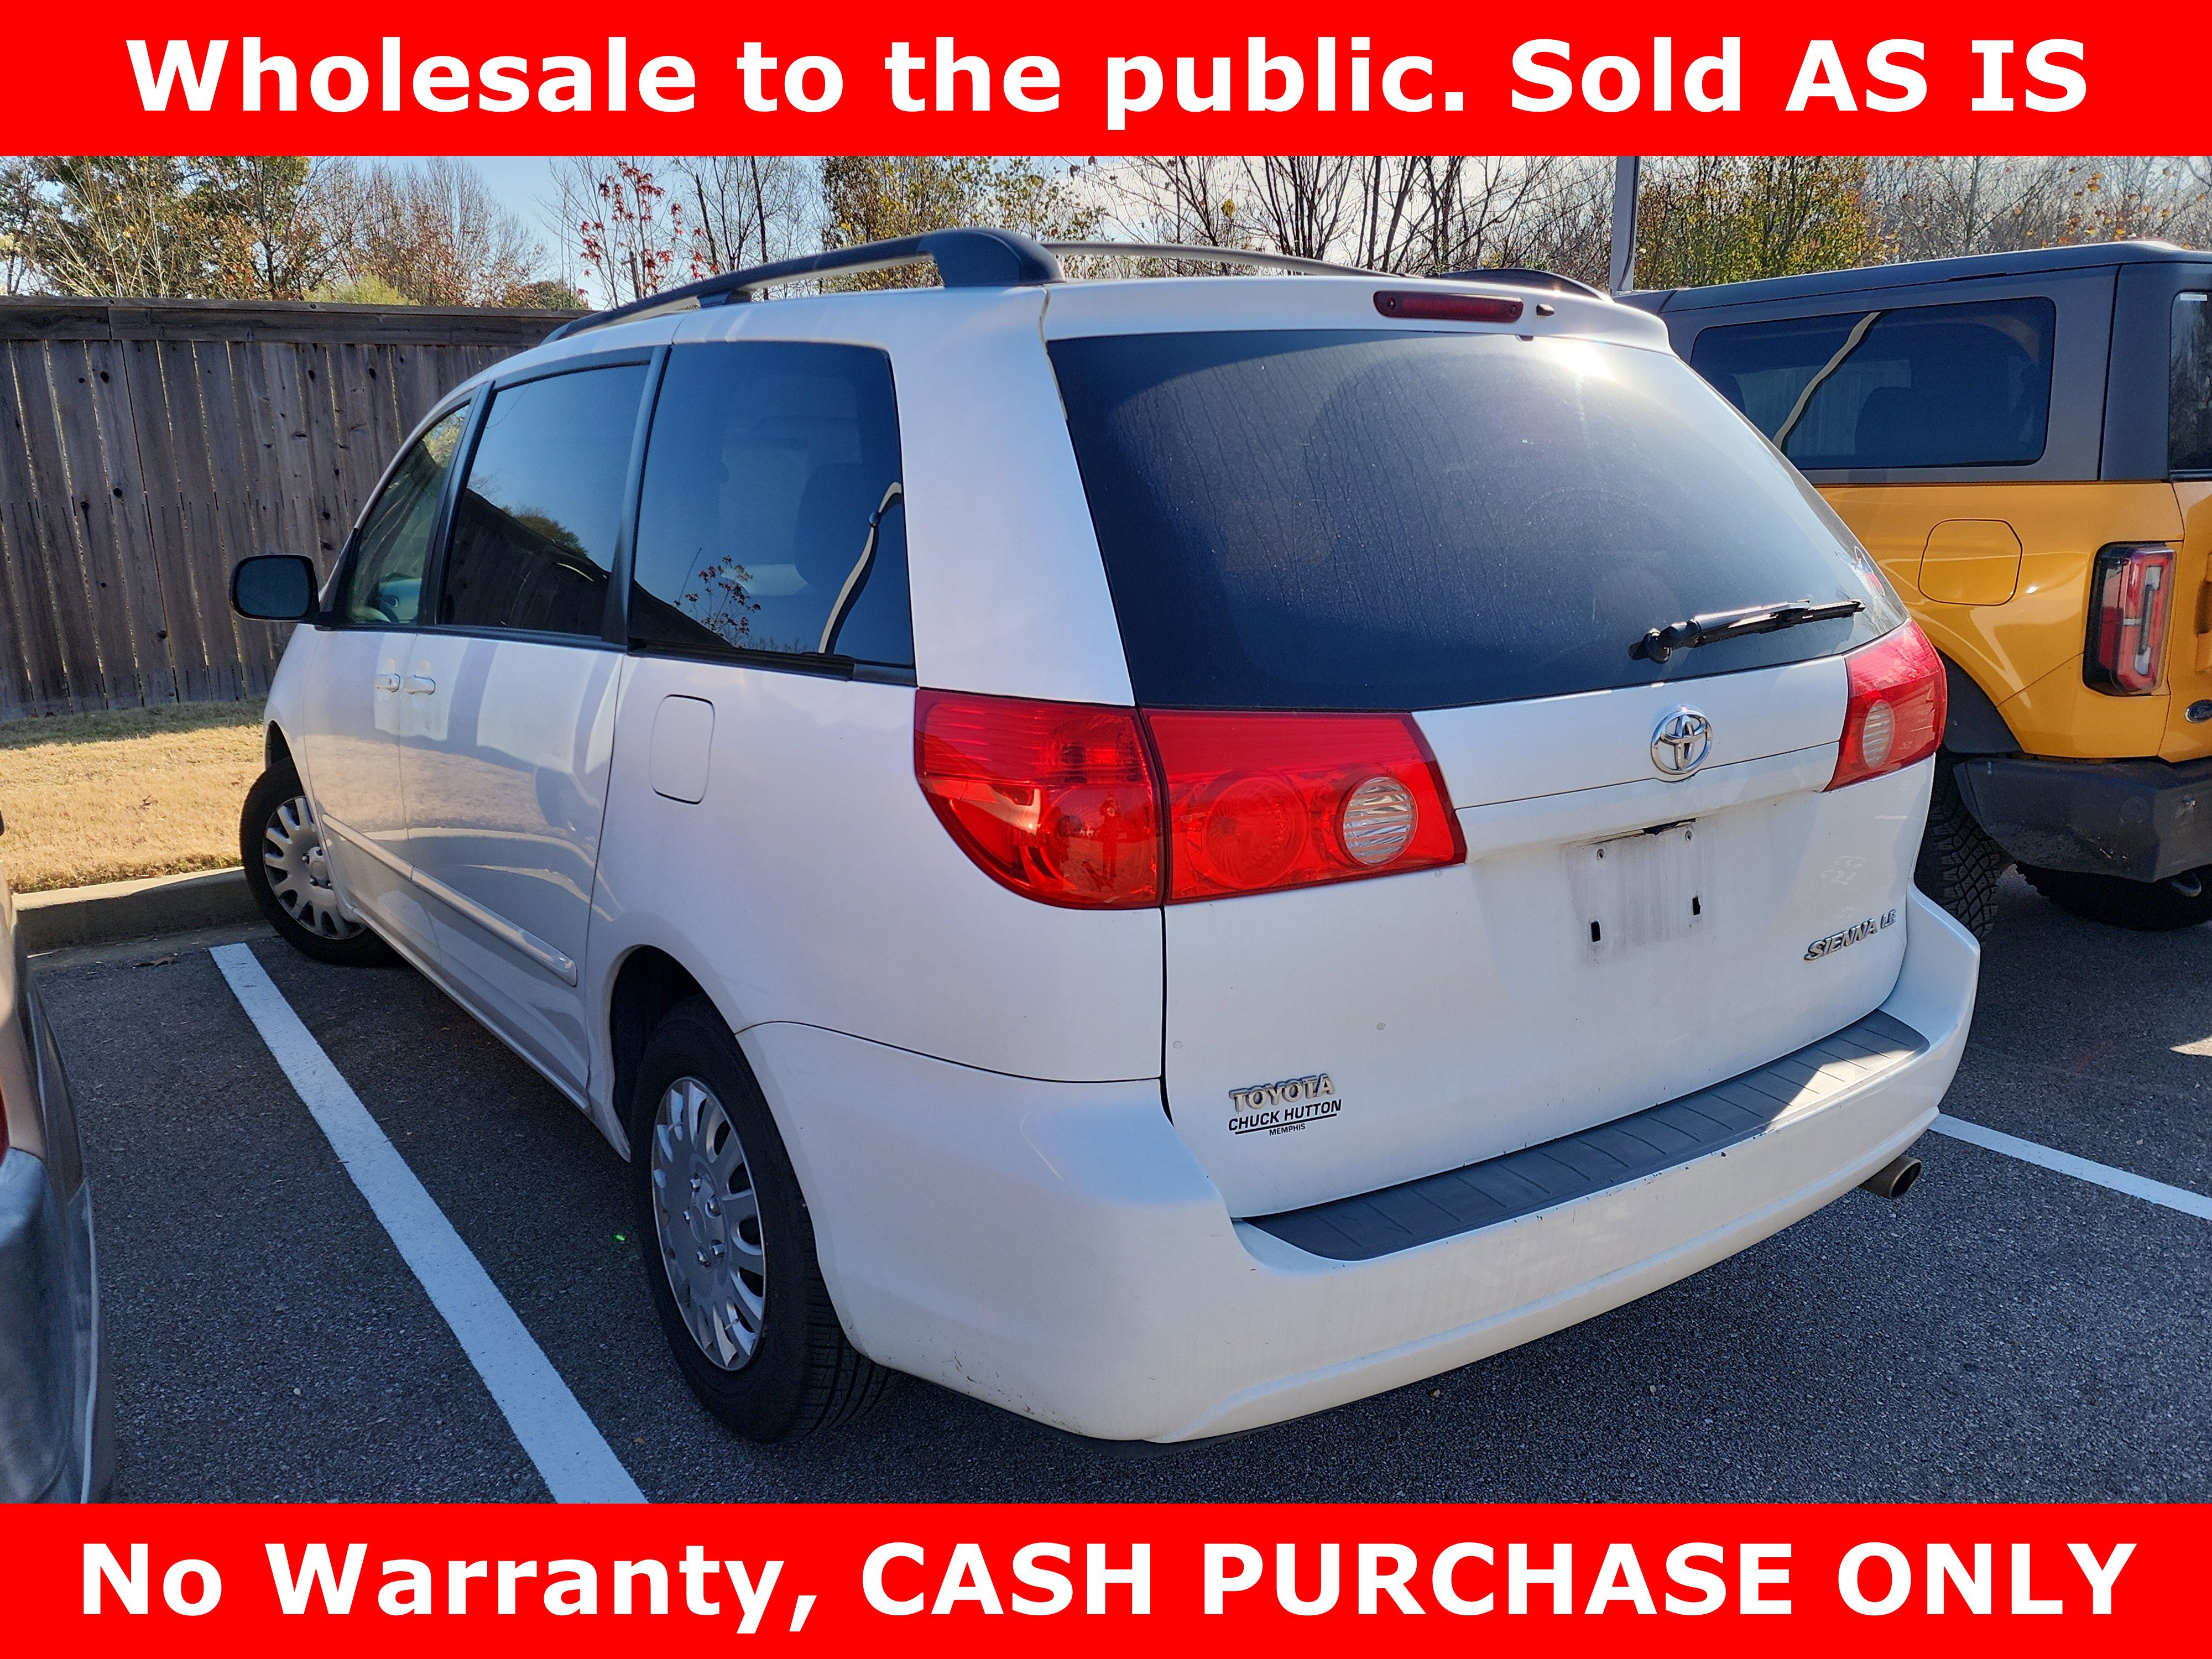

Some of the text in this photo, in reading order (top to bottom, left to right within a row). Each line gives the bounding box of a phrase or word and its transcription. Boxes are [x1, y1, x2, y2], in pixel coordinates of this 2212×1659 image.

[1804, 909, 1896, 961] SIENNA LE
[1229, 1073, 1335, 1113] TOYOTA
[1228, 1099, 1342, 1130] CHUCK HUTTON
[1269, 1123, 1306, 1136] MEMPHIS
